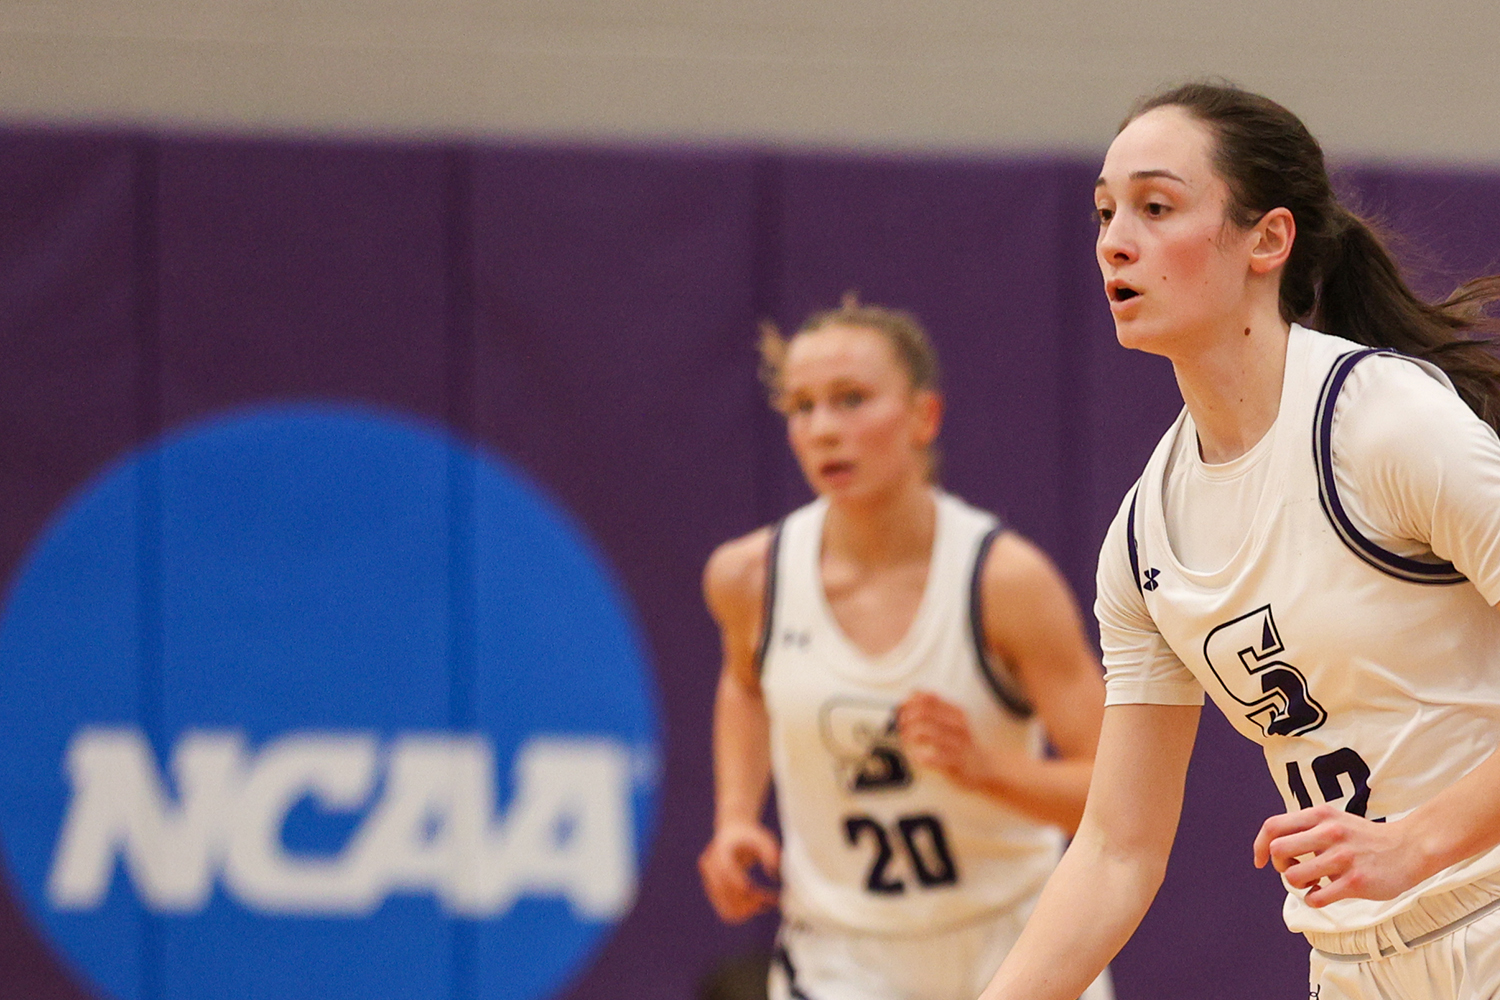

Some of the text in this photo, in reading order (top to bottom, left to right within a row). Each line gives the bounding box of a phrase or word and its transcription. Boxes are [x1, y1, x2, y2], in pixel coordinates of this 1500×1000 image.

[1203, 603, 1328, 738] S
[49, 728, 637, 917] NCAA
[844, 814, 960, 896] 20
